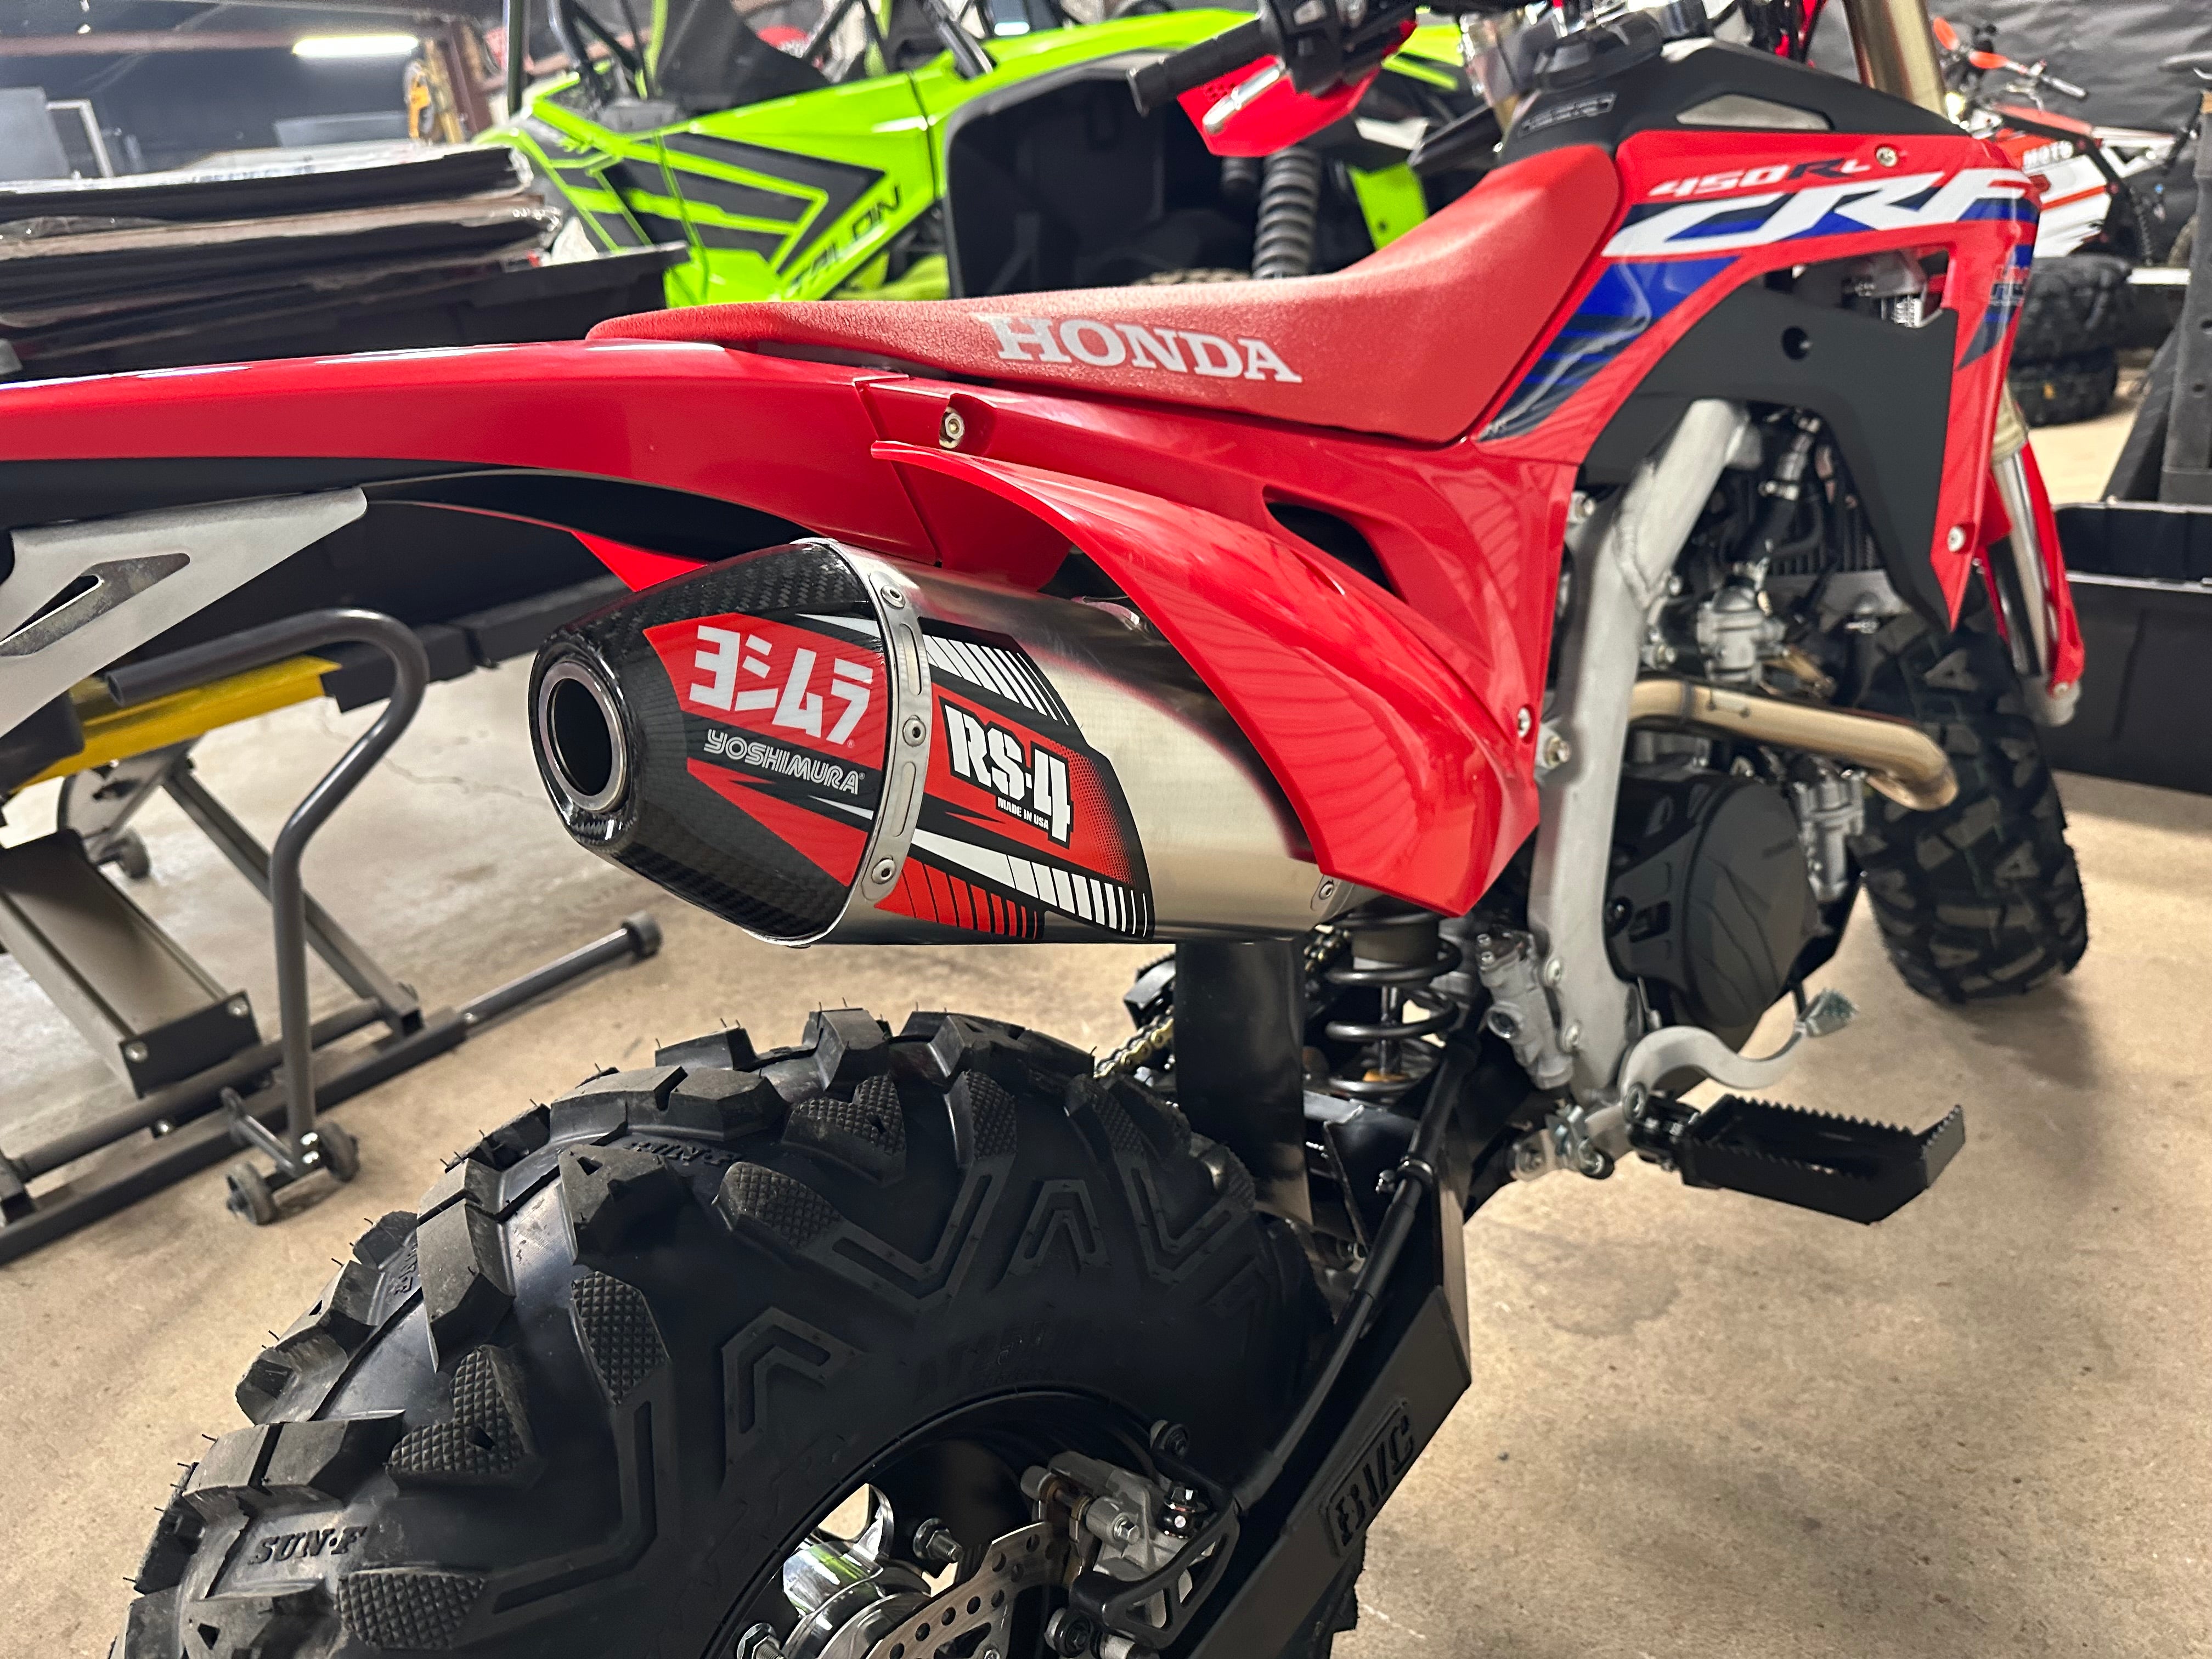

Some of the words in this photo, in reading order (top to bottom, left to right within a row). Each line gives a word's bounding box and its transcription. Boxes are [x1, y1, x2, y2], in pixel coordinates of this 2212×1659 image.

[1648, 157, 1871, 198] 450RL
[1601, 167, 2034, 257] CRF
[982, 315, 1302, 383] HONDA
[689, 625, 874, 745] ヨシムラ
[703, 729, 859, 795] YOSHIMURA
[945, 704, 1070, 842] RS-4
[997, 796, 1022, 817] MADE
[1023, 808, 1032, 822] IN
[1034, 814, 1049, 830] USA
